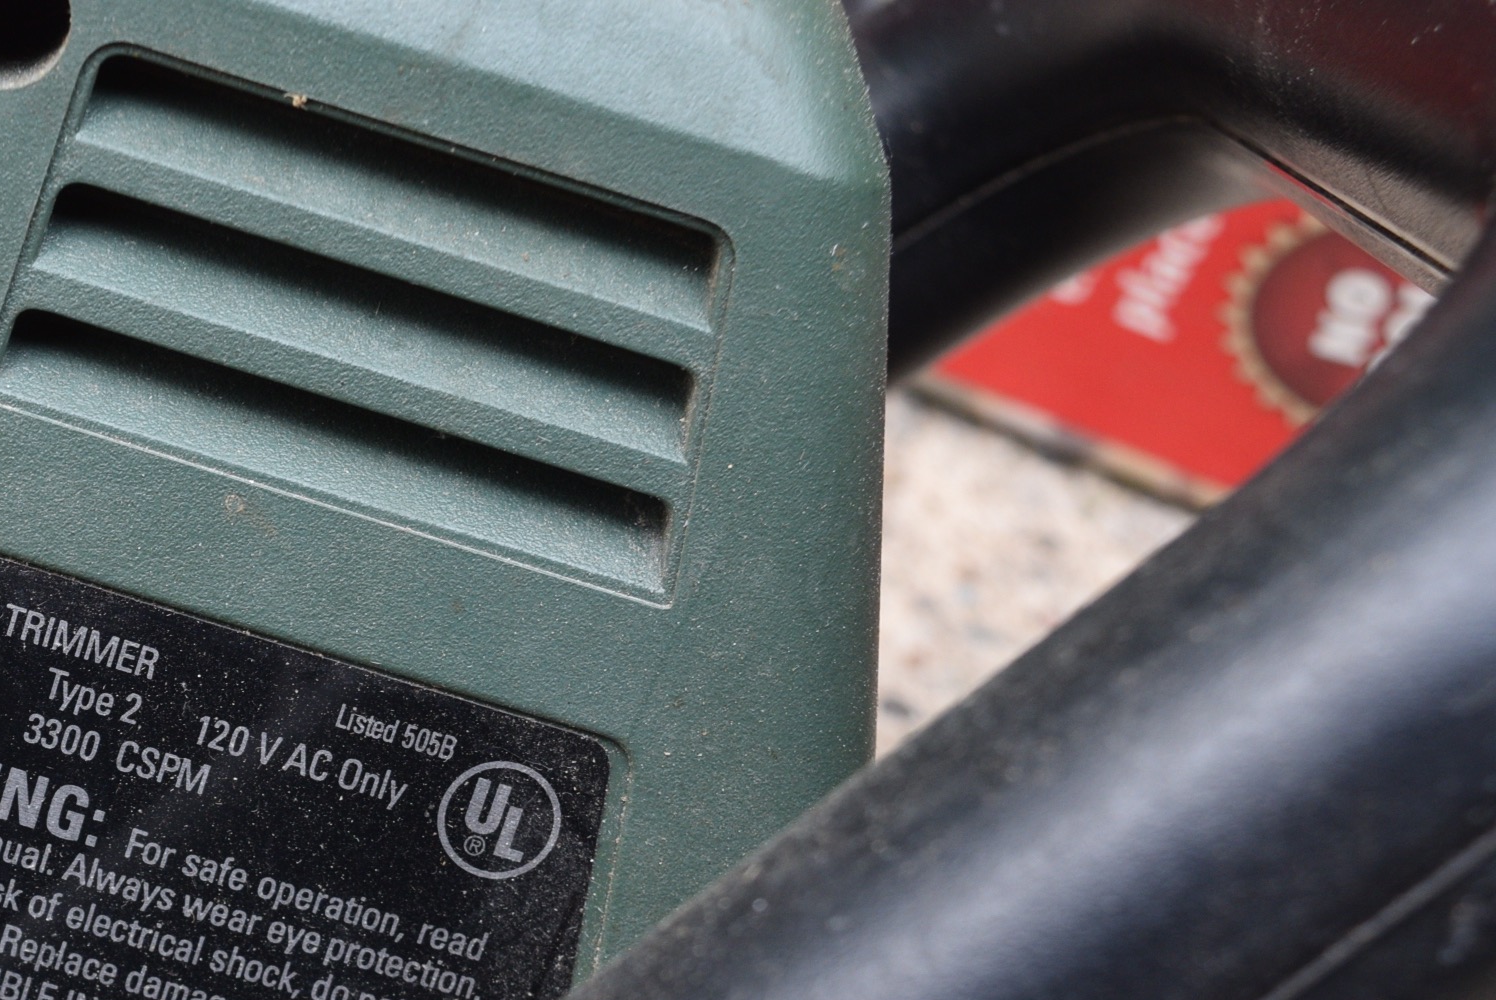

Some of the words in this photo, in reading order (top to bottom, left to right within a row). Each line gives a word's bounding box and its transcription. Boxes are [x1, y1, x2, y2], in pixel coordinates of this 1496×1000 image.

[5, 603, 159, 680] TRIMMER
[23, 713, 101, 761] 3300
[116, 740, 211, 796] CSPM
[49, 668, 114, 717] Type
[120, 692, 142, 725] 2
[197, 715, 251, 757] 120
[260, 731, 284, 766] V
[283, 742, 335, 782] AC
[338, 757, 409, 811] Only
[335, 703, 398, 744] Listed
[402, 726, 458, 762] 505B
[464, 777, 524, 863] UL
[61, 853, 175, 913] Always
[183, 893, 262, 935] wear
[267, 920, 319, 954] eye
[125, 828, 176, 869] For
[182, 853, 248, 891] safe
[257, 876, 404, 943] operation,
[416, 921, 489, 962] read
[0, 925, 117, 986] Replace
[28, 893, 64, 921] of
[66, 904, 205, 965] electrical
[210, 945, 302, 999] shock,
